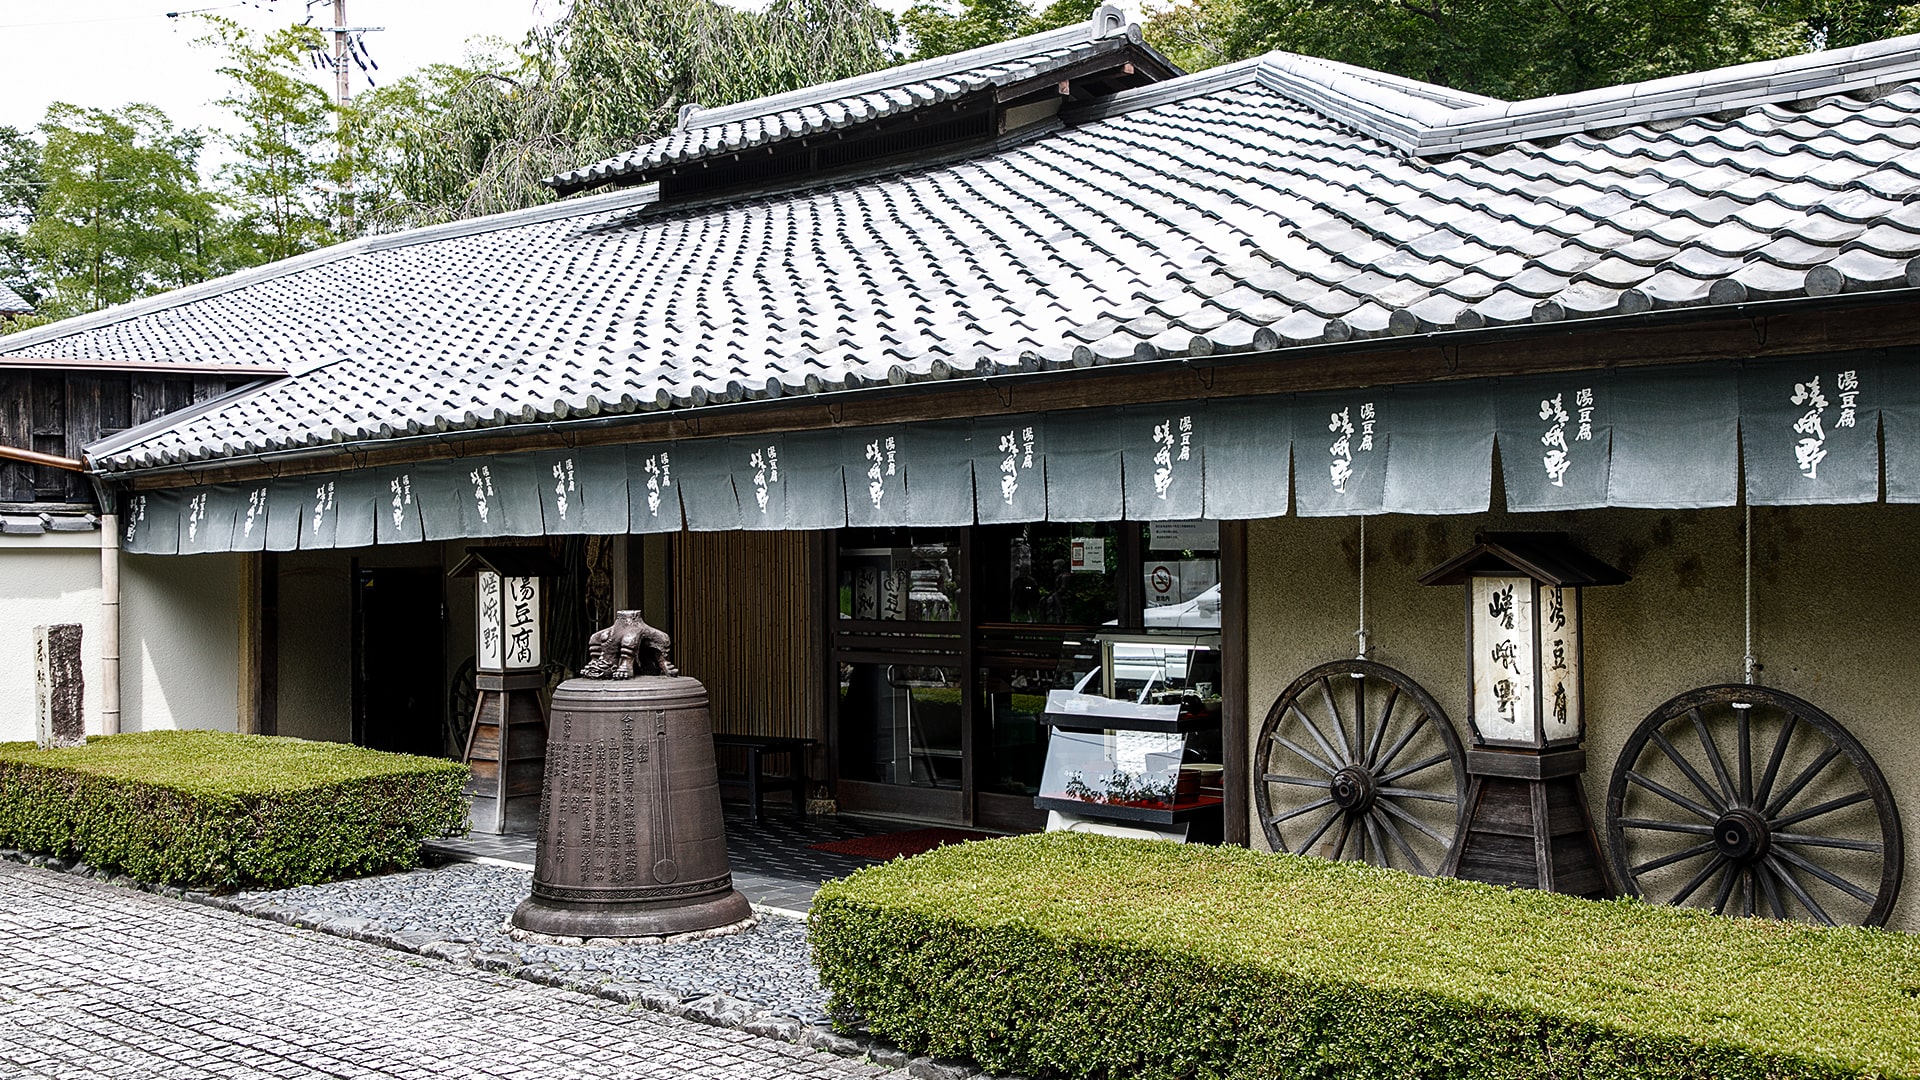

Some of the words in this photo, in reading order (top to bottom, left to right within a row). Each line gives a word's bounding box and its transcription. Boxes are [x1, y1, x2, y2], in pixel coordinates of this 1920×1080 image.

[1358, 403, 1375, 451] 湯豆腐
[1575, 389, 1594, 441] 湯豆腐
[1791, 376, 1828, 478] 嵯峨野
[1835, 371, 1859, 428] 湯豆腐
[768, 446, 777, 482] 湯豆腐
[866, 440, 884, 509] 嵯峨野
[886, 437, 896, 476] 湯豆腐
[999, 431, 1018, 504] 嵯峨野
[1022, 427, 1034, 468] 湯豆腐
[1153, 420, 1174, 499] 嵯峨野
[1177, 416, 1192, 461] 湯豆腐
[1329, 407, 1354, 493] 嵯峨野
[1539, 393, 1570, 486] 嵯峨野
[482, 573, 499, 658] 嵯峨野
[507, 577, 535, 663] 湯豆腐
[1489, 584, 1520, 724] 嵯峨野
[1550, 588, 1567, 725] 湯豆腐
